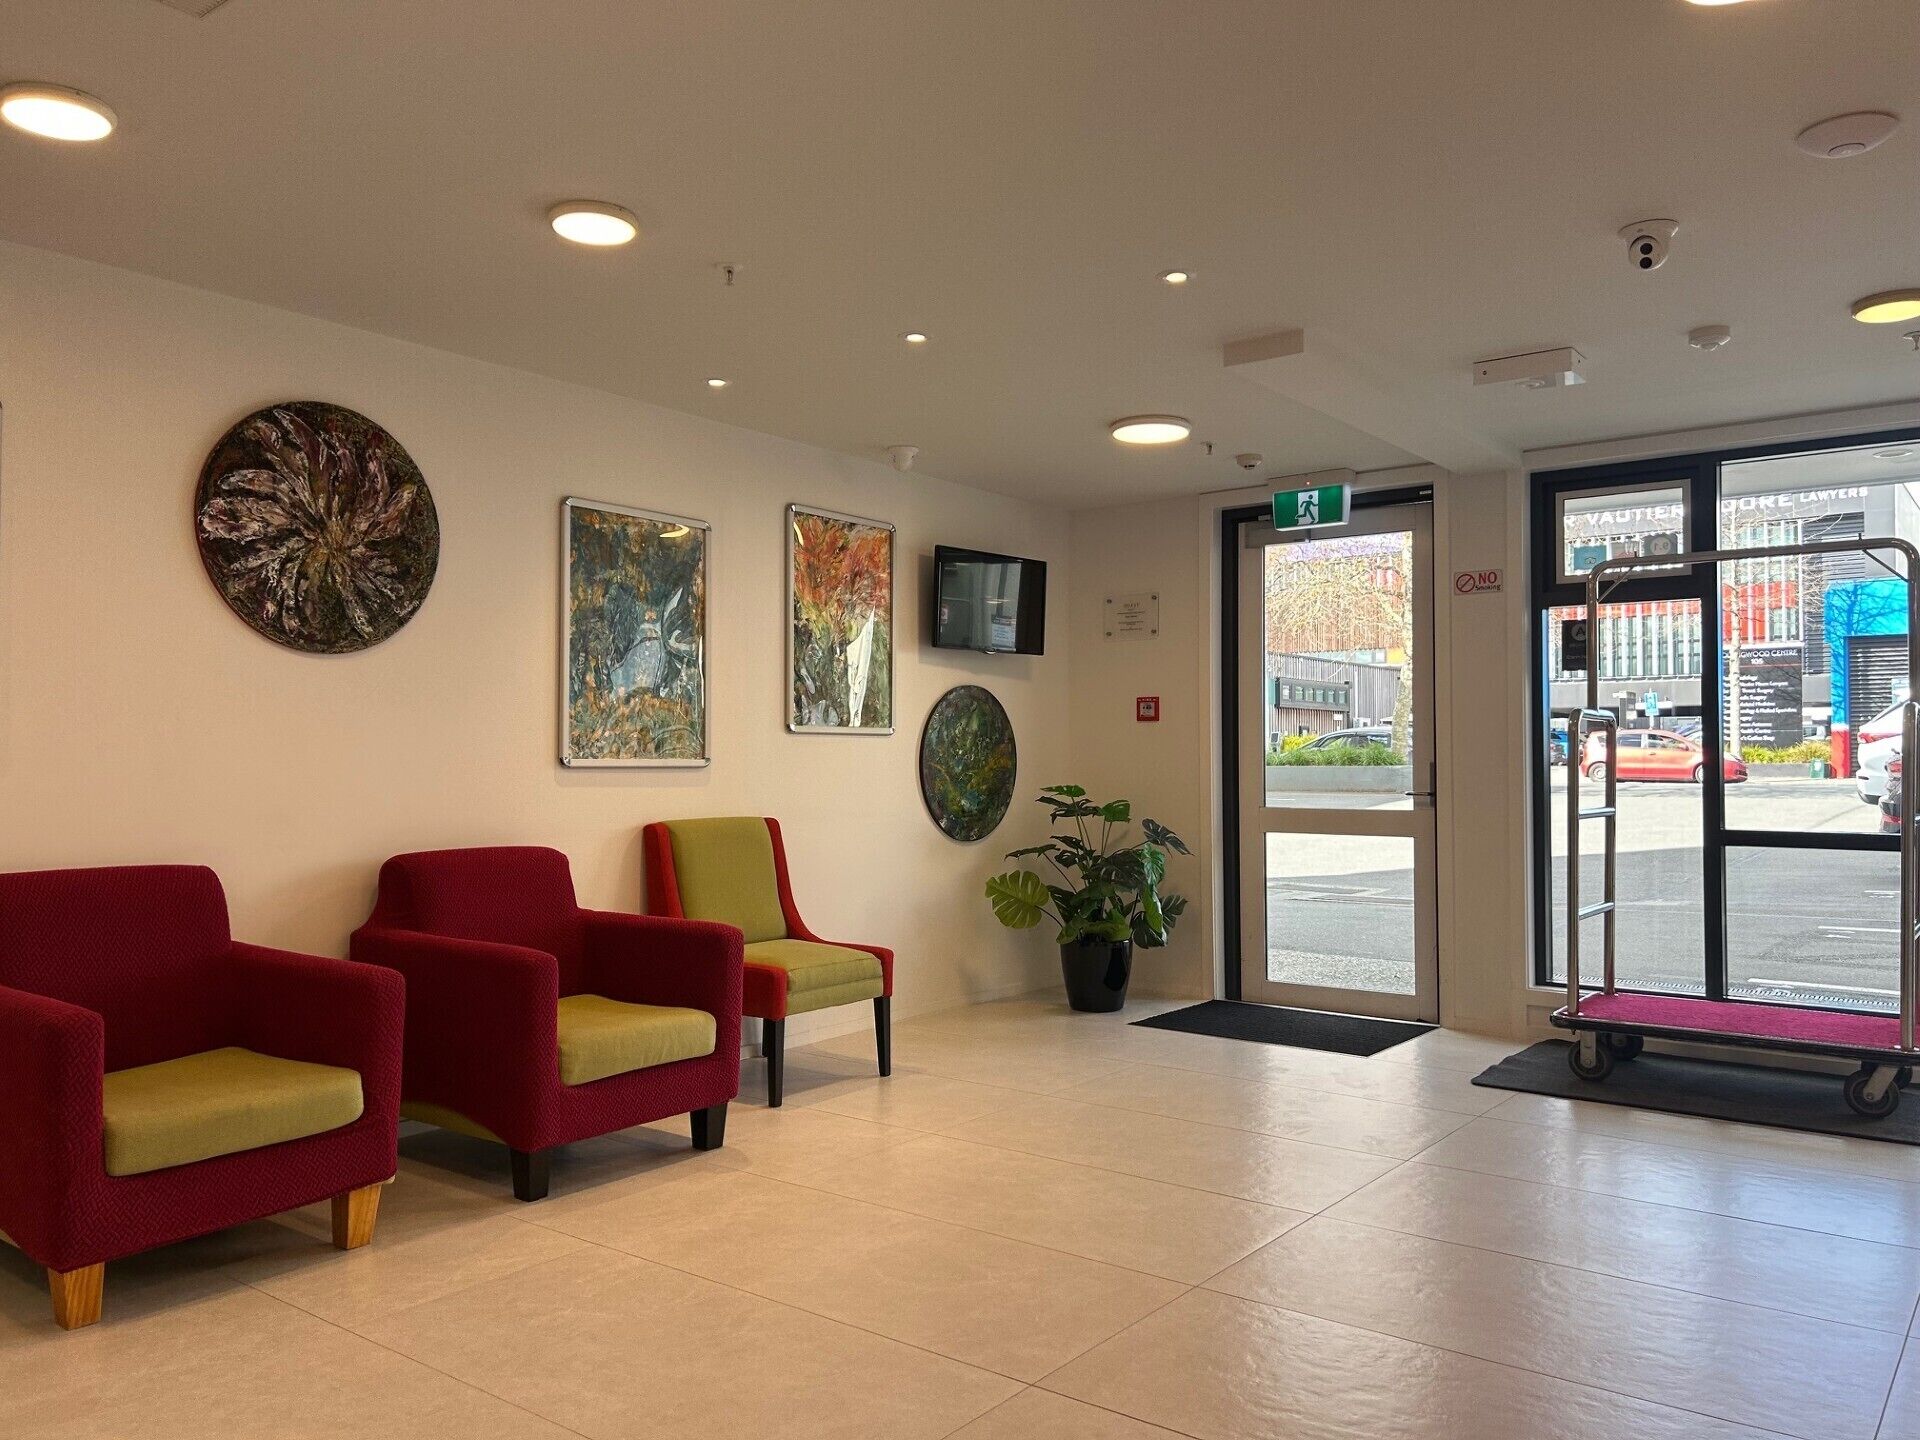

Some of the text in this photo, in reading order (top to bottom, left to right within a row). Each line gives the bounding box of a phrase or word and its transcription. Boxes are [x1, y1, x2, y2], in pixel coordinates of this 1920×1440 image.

[1720, 486, 1869, 512] OORE LAWYERS
[1585, 504, 1683, 525] VAUTIER
[1478, 572, 1498, 585] NO
[1771, 648, 1798, 657] CENTRE
